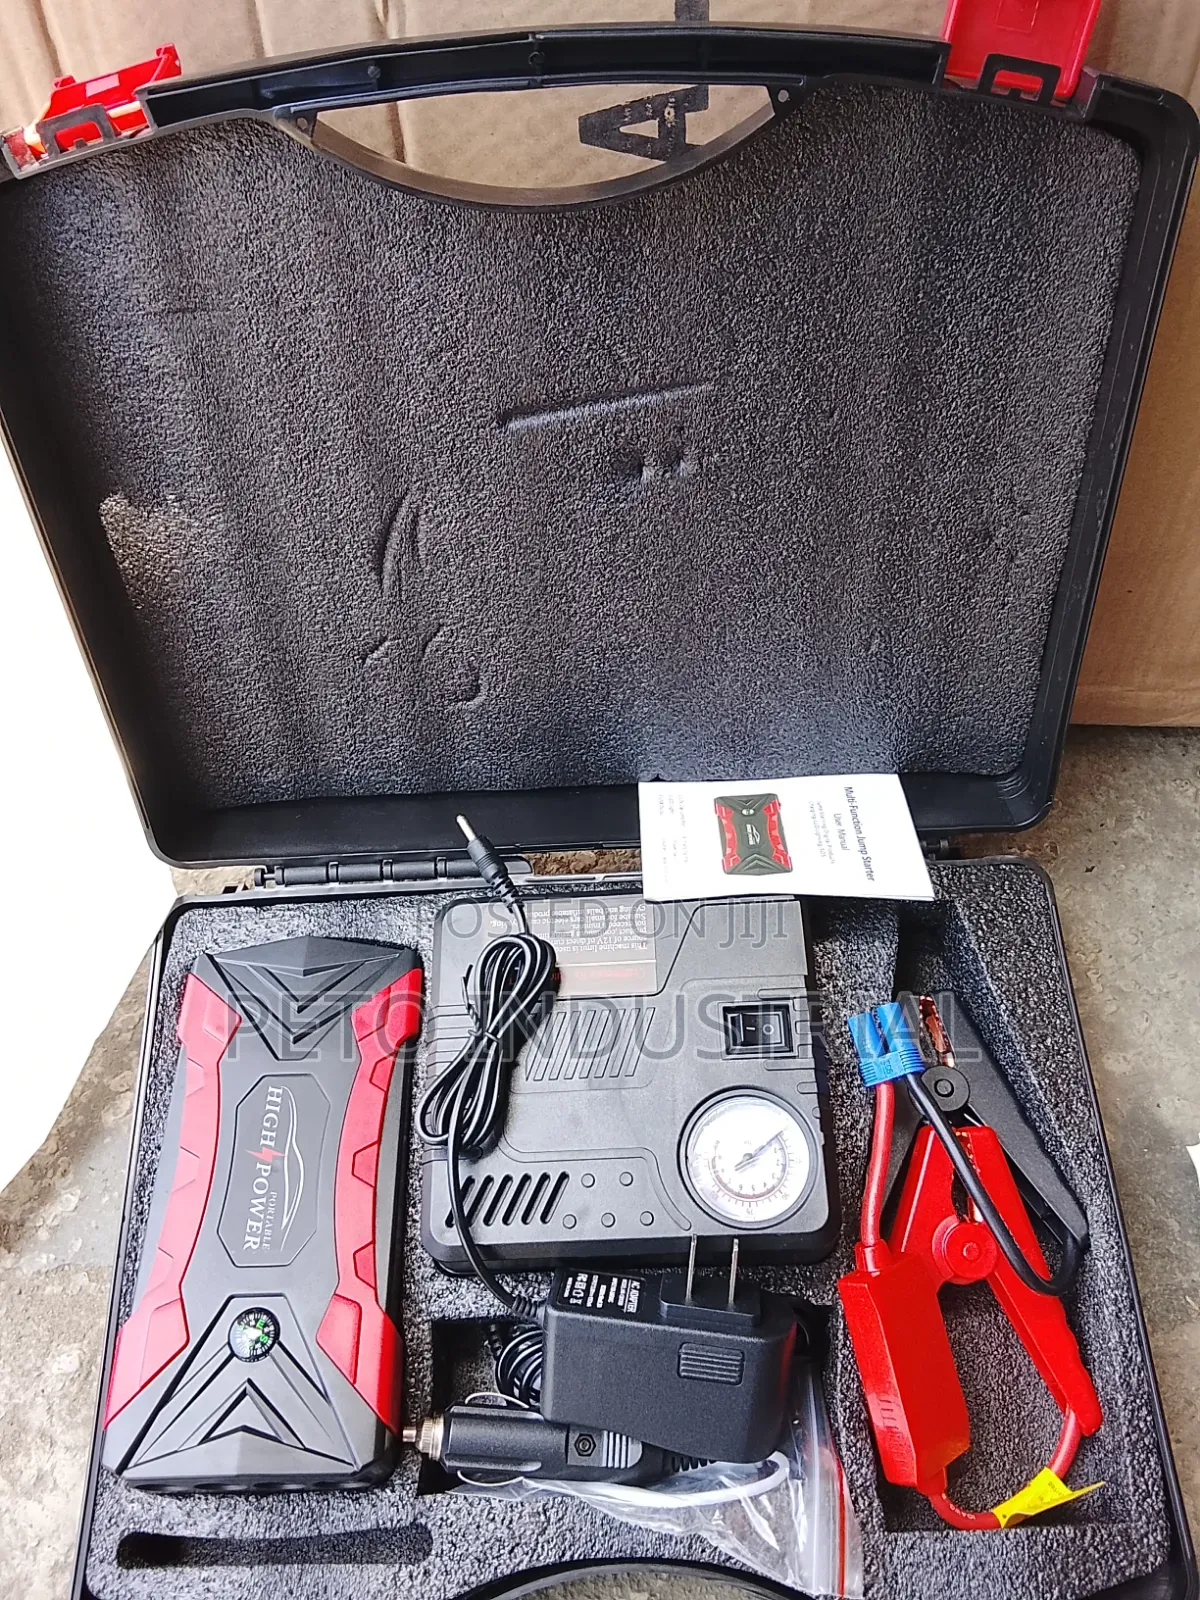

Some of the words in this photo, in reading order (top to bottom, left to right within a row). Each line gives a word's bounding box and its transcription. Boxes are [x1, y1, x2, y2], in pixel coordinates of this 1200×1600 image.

[833, 813, 842, 826] User
[837, 829, 850, 850] Manual
[844, 786, 862, 835] Multi-Function
[856, 836, 868, 855] Jump
[862, 856, 875, 881] Starter
[598, 943, 630, 952] machine
[631, 942, 648, 950] This
[259, 1085, 284, 1148] HIGH
[243, 1161, 273, 1251] POWER
[262, 1191, 278, 1251] PORTABLE
[626, 1289, 639, 1313] ADAPTER
